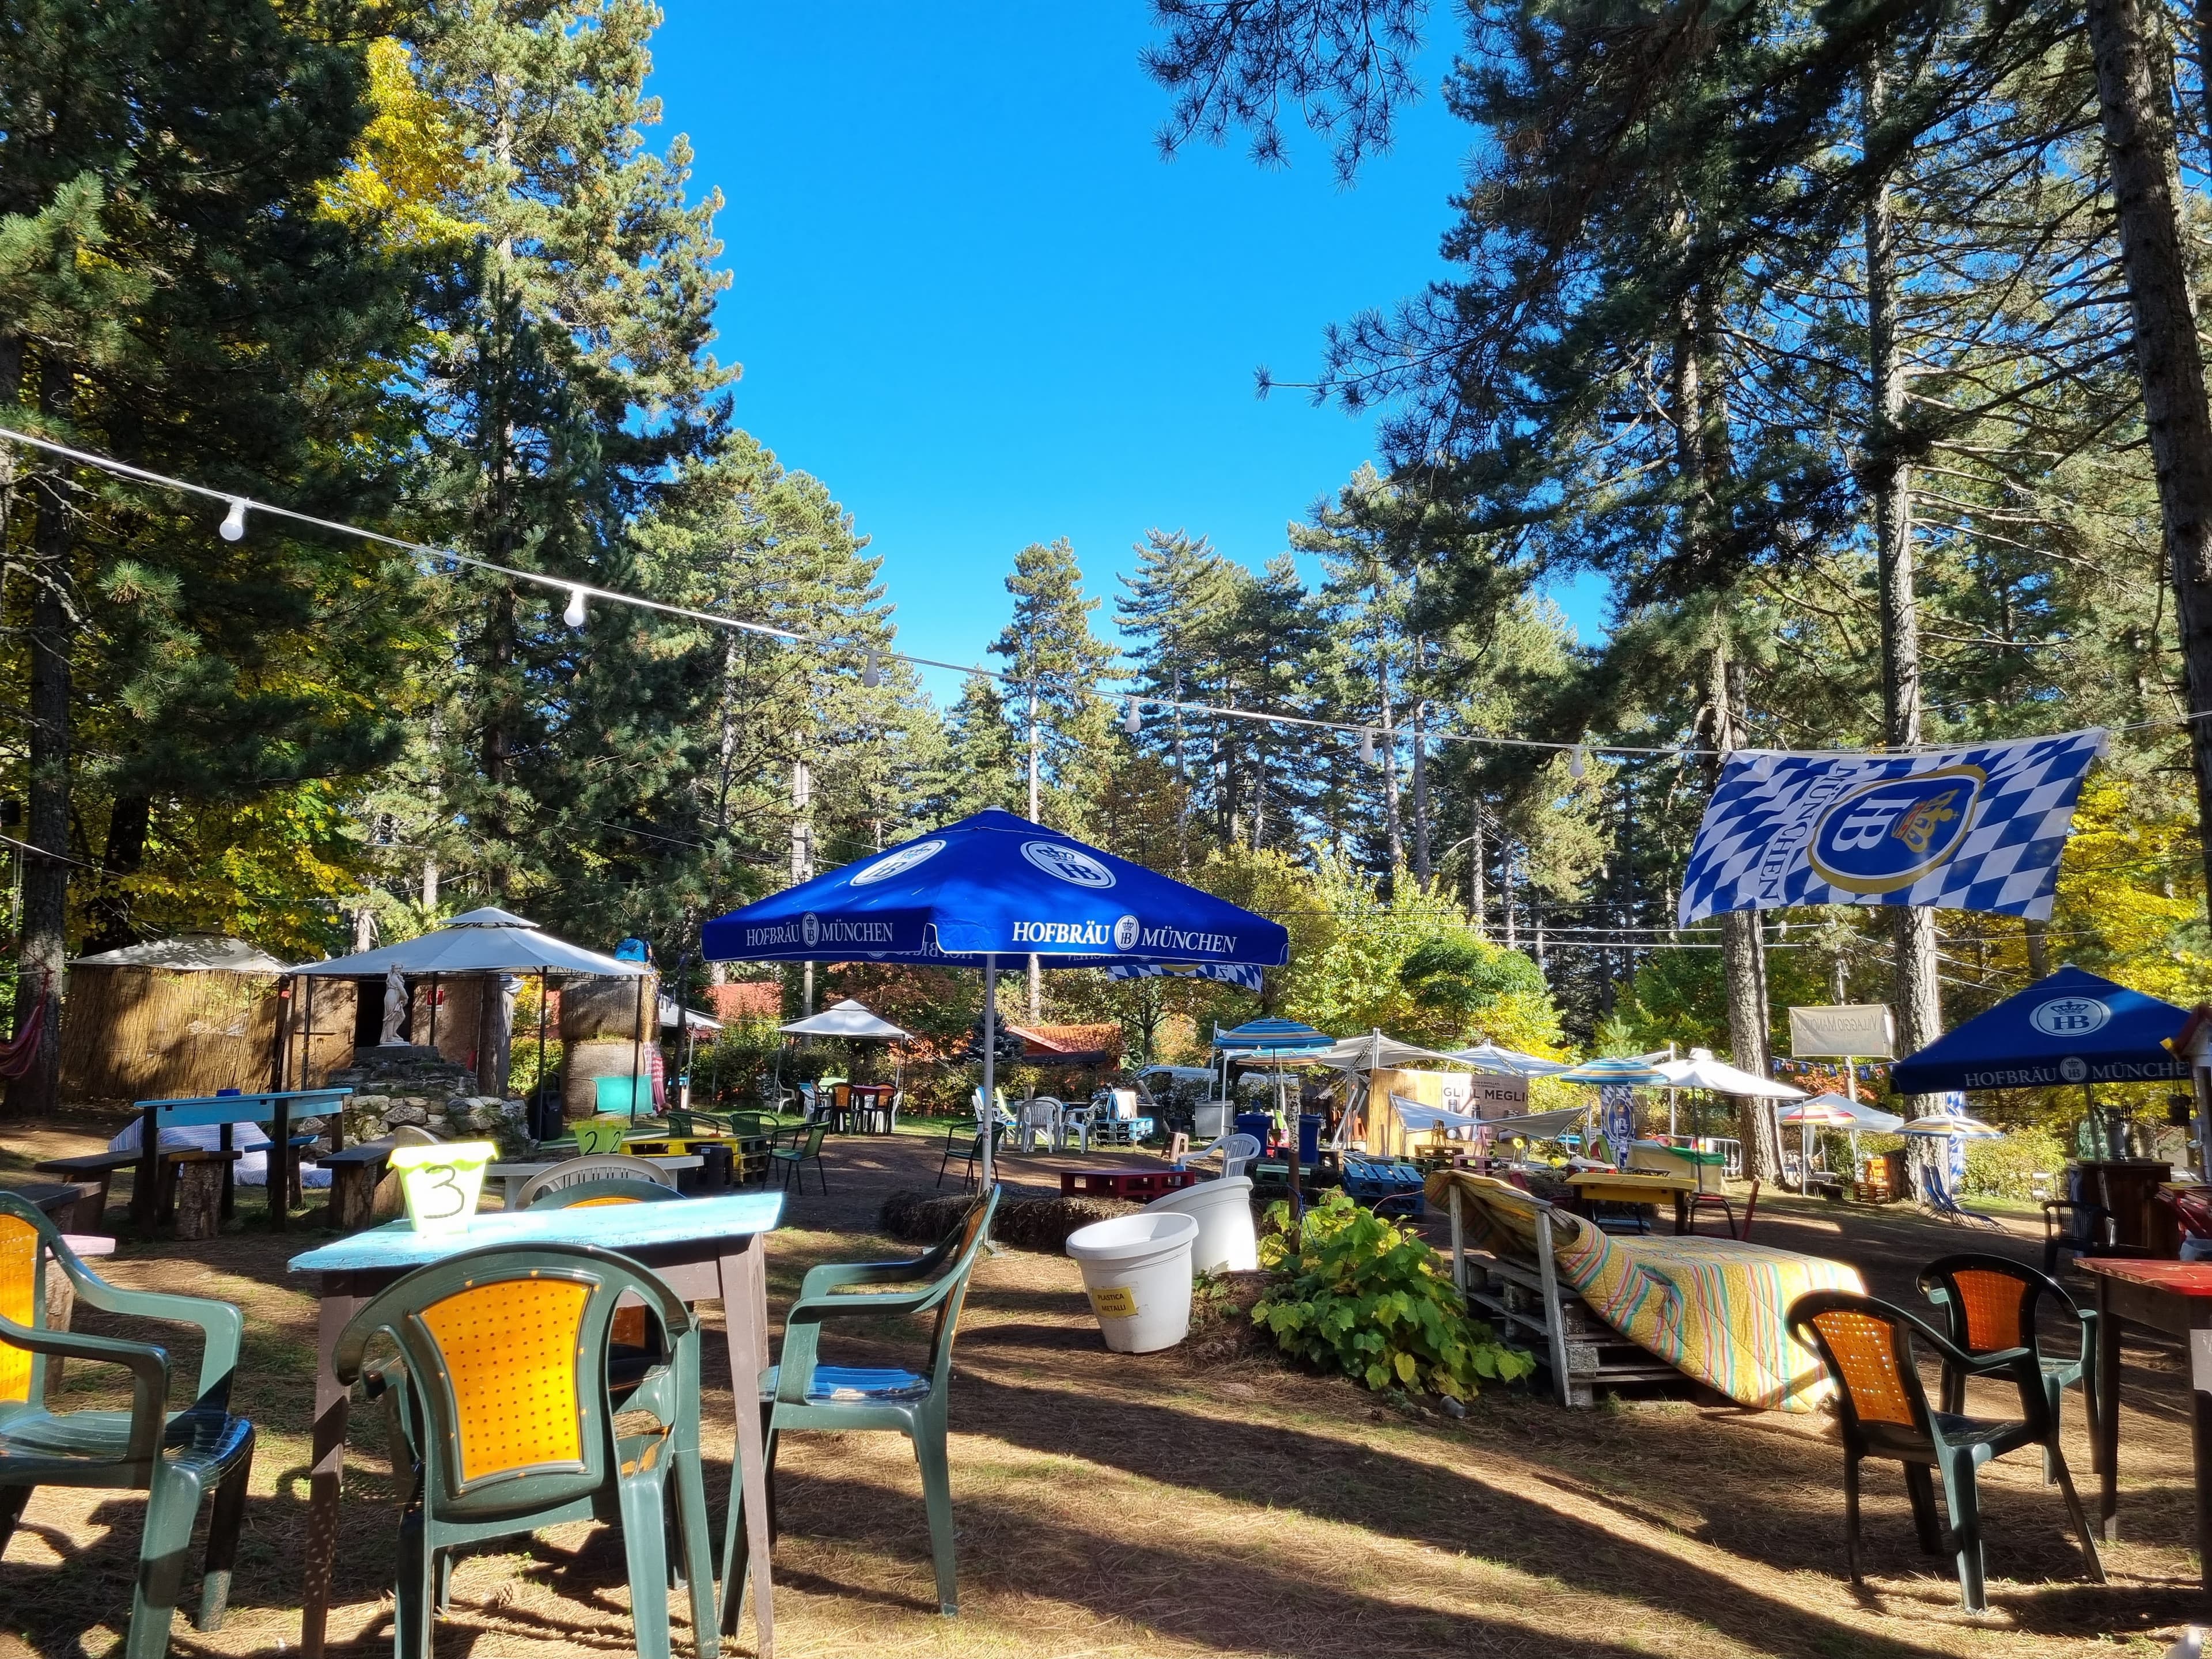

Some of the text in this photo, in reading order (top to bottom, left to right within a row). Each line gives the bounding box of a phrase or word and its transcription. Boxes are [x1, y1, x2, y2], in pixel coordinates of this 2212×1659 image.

[1832, 797, 1920, 851] HB
[1053, 862, 1101, 881] HB
[747, 922, 800, 946] HOFBRÄU
[821, 919, 893, 942] MÜNCHEN
[1012, 920, 1110, 945] HOFBRÄU
[1141, 926, 1237, 953] MÜNCHEN
[2052, 1016, 2090, 1031] HB
[1963, 1066, 2056, 1087] HOFBRÄU
[2091, 1061, 2189, 1079] MÜNCHE
[1485, 1089, 1528, 1102] MEGLI
[423, 1164, 465, 1219] 3
[1101, 1304, 1126, 1312] METALLI
